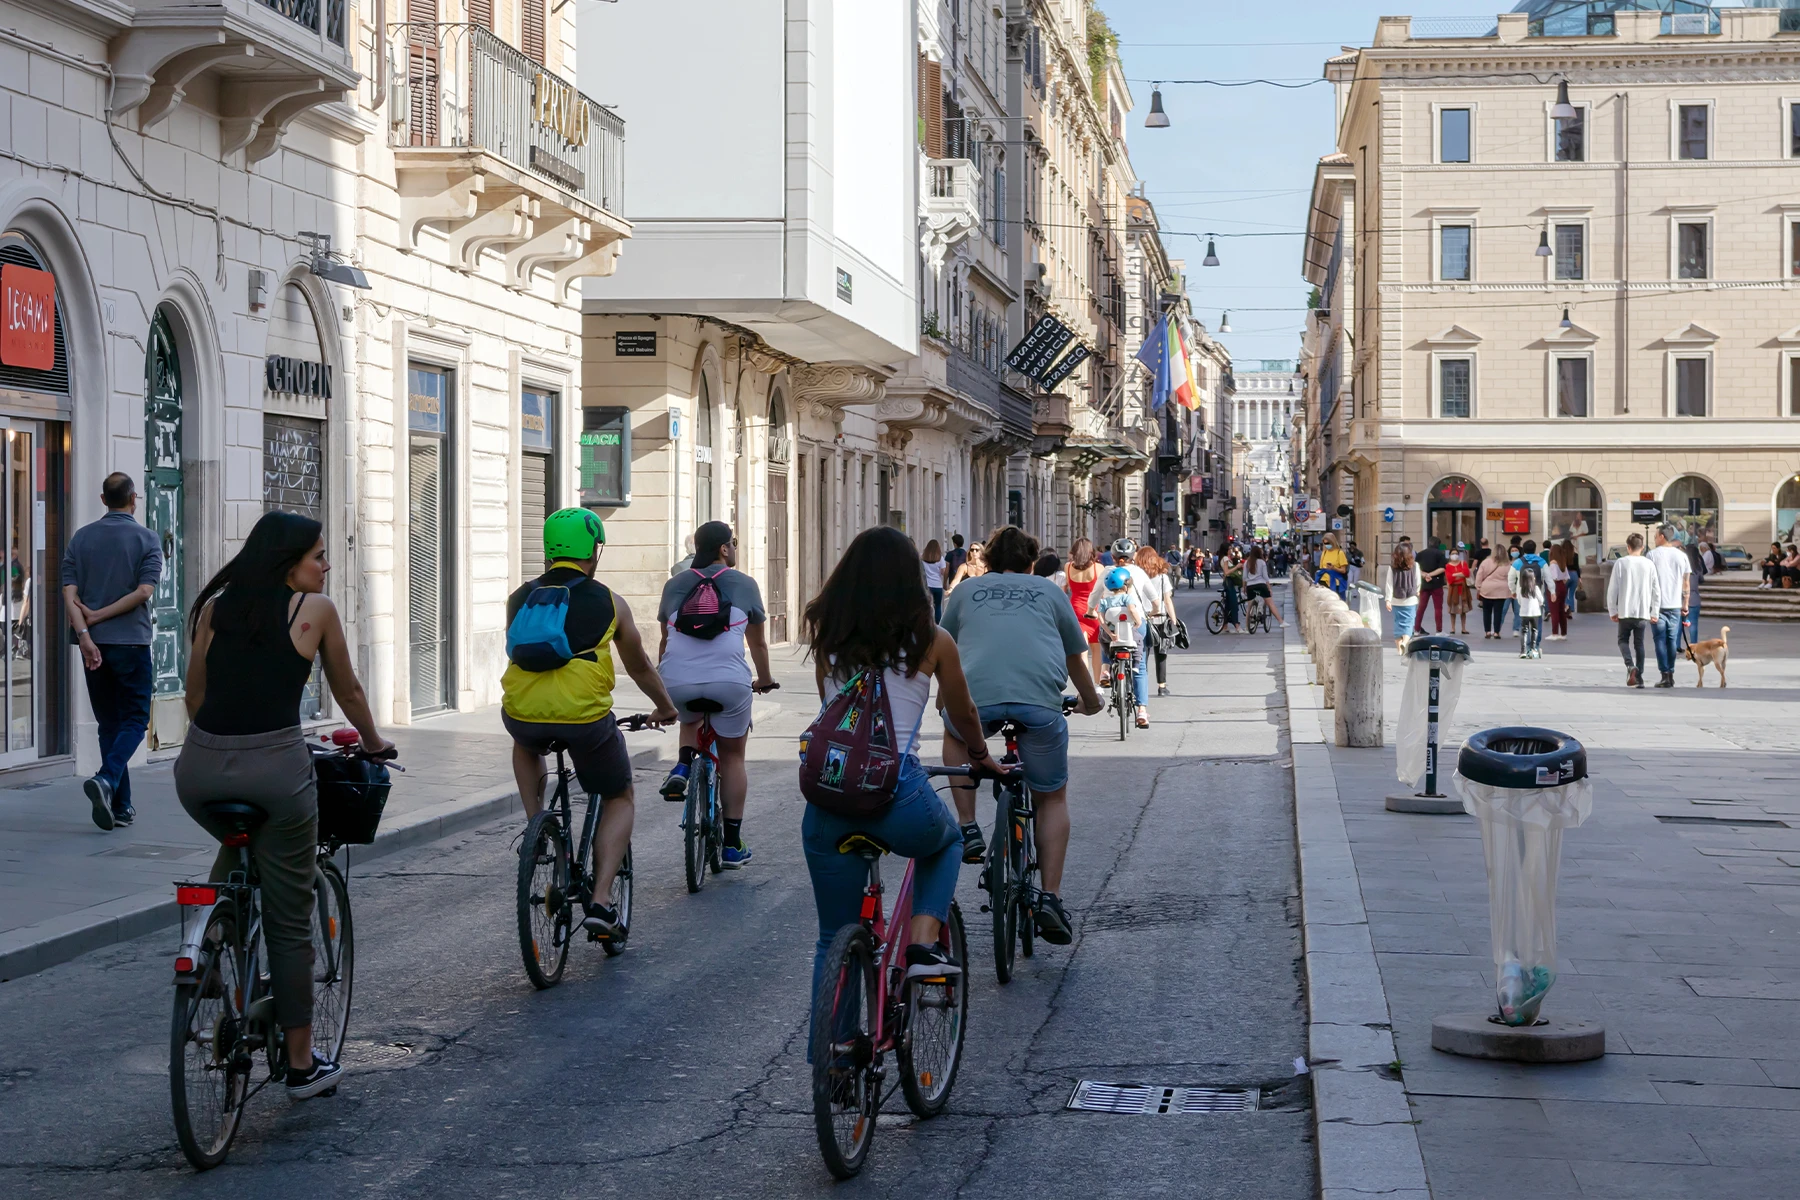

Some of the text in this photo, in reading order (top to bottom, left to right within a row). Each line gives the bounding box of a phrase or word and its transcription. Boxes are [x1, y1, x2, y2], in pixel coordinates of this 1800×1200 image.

[1009, 317, 1055, 366] GUESS
[1030, 330, 1070, 377] GUESS
[267, 353, 333, 399] CHOPIN
[1043, 347, 1087, 388] GUESS
[972, 588, 1044, 603] OBEY
